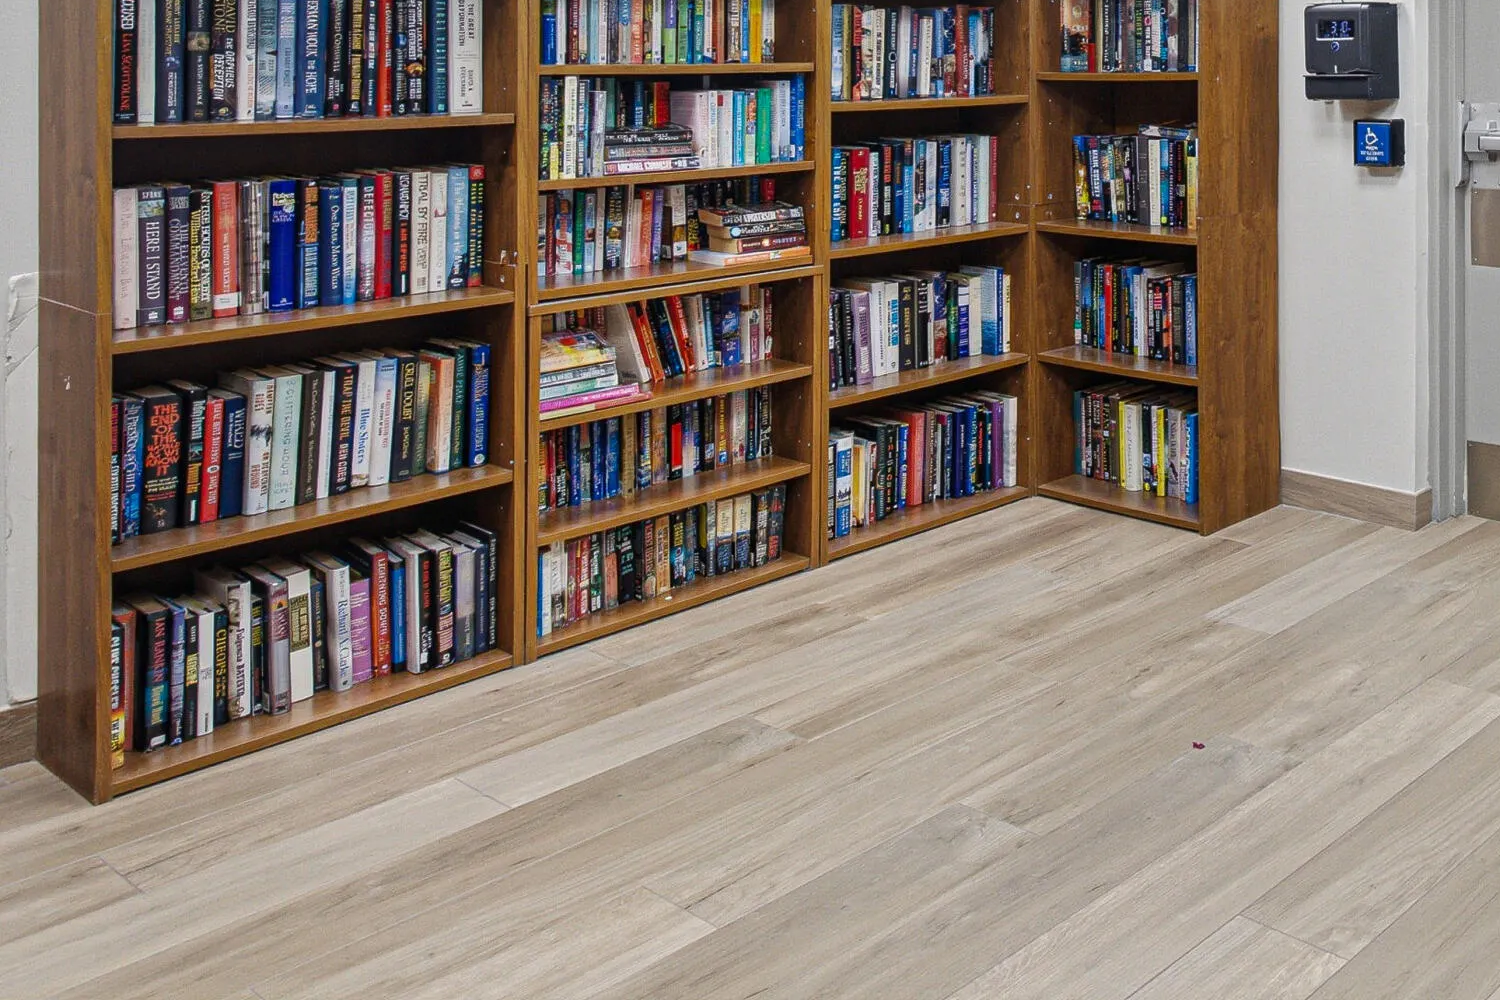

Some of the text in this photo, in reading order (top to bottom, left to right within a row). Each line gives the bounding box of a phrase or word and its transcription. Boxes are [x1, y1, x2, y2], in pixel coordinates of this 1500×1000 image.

[306, 32, 319, 56] WOUK
[120, 55, 132, 110] SCOTTOLINE
[305, 72, 317, 94] HOPE
[417, 174, 428, 245] TRIAL BY FIRE
[146, 222, 161, 252] HERE
[168, 218, 181, 301] COMMANDMENT
[146, 263, 161, 299] STAND
[153, 403, 179, 415] THE
[402, 363, 415, 420] CRUEL DOUBT
[151, 413, 180, 426] END
[336, 375, 353, 483] TRAP THE DEVIL BEN COES
[152, 432, 177, 445] THE
[358, 432, 369, 464] Sisters
[377, 558, 388, 635] LIGHTNING DOWN
[153, 618, 166, 683] IAN RANKIN
